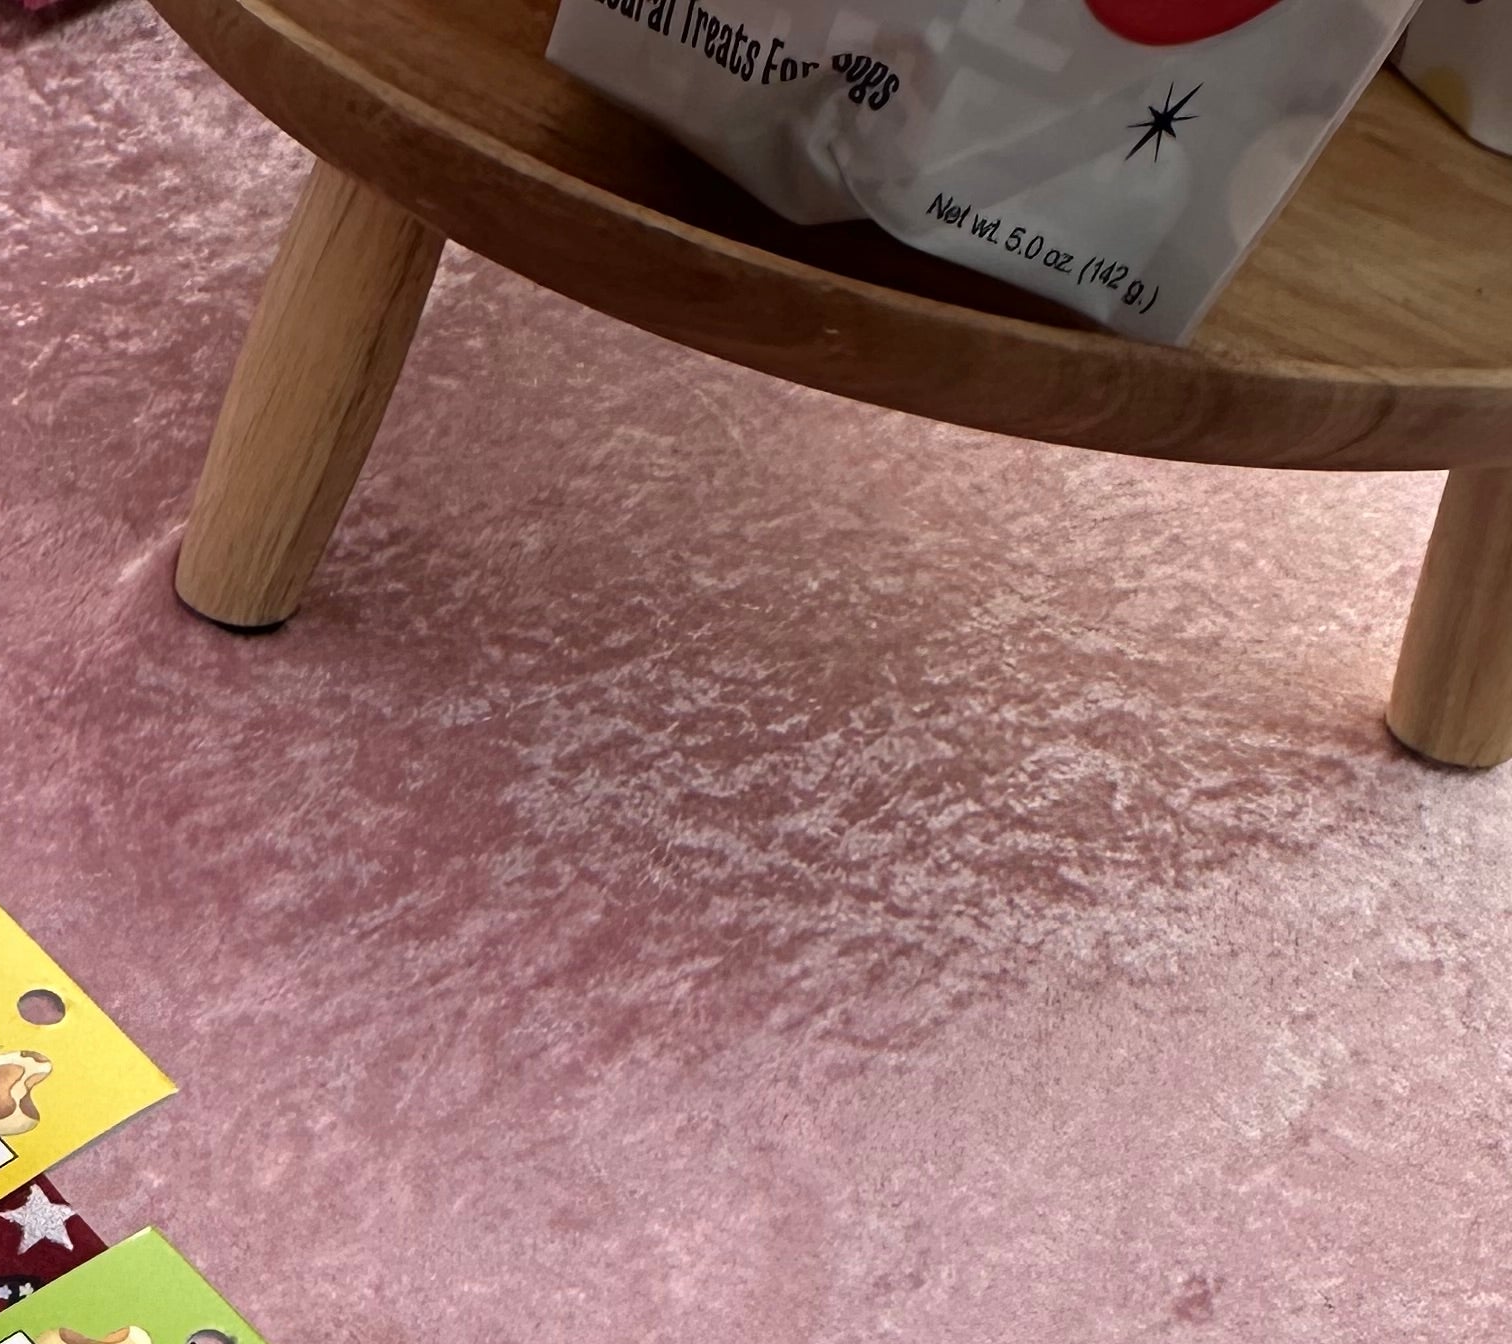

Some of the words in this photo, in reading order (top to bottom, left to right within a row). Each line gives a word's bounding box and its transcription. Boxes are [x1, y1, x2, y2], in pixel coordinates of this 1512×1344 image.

[761, 38, 820, 84] For
[926, 192, 972, 228] Net
[1005, 227, 1044, 259] 5.0
[1077, 256, 1128, 290] (142
[1122, 280, 1159, 314] g.)
